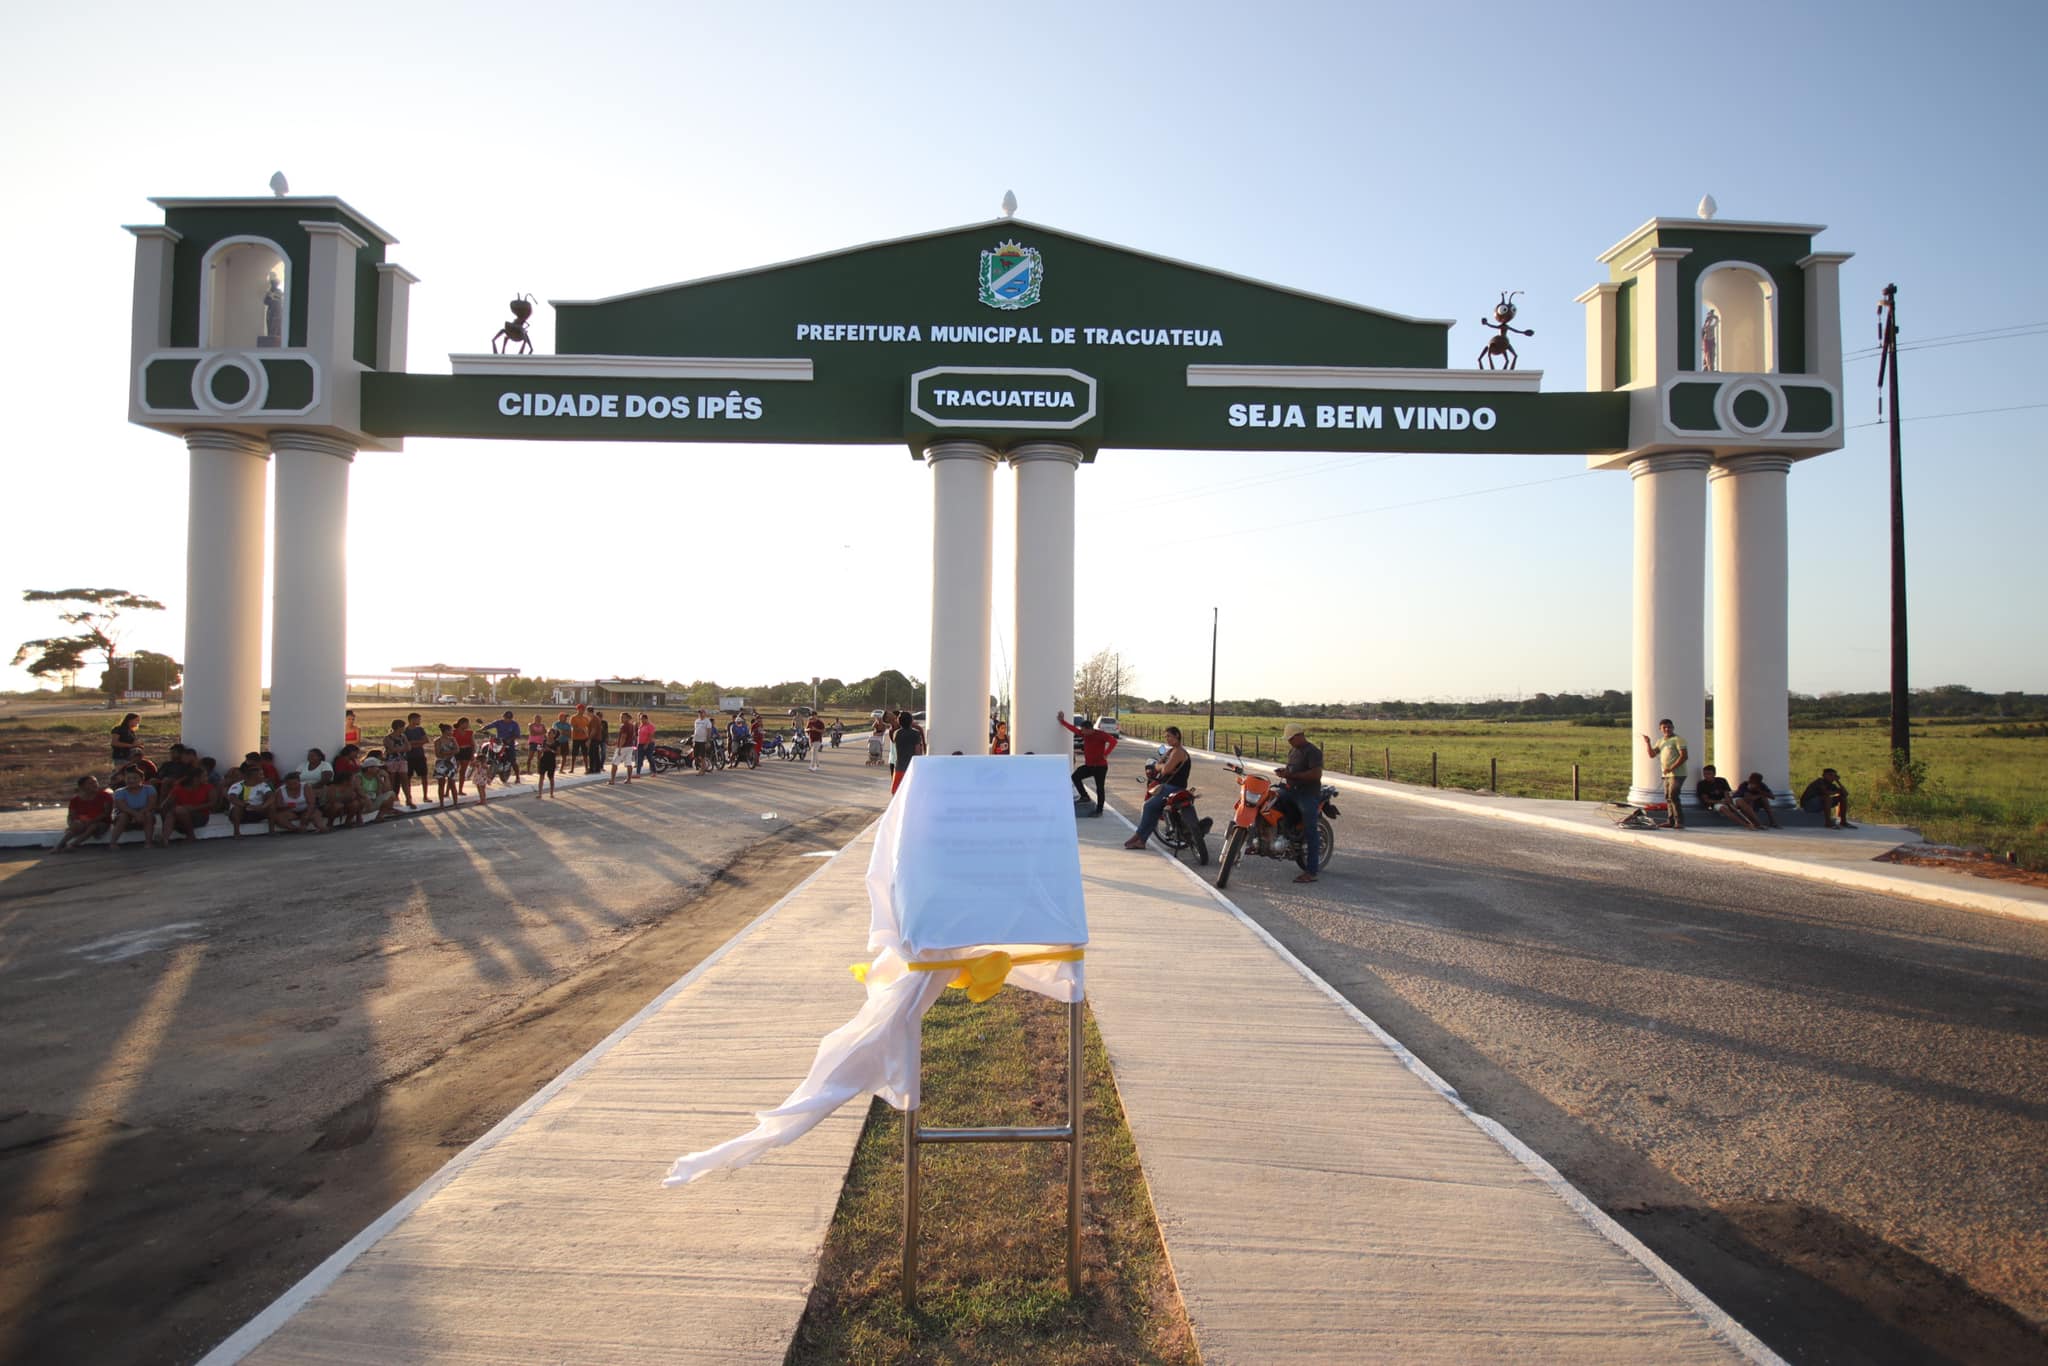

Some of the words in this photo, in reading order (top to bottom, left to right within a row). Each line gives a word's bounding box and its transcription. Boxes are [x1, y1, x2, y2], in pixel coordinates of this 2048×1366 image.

[797, 324, 921, 343] PREFEITURA
[931, 326, 1043, 345] MUNICIPAL
[1051, 327, 1076, 345] DE
[1084, 328, 1223, 347] TRACUATEUA
[498, 392, 618, 418] CIDADE
[625, 395, 690, 420] DOS
[697, 390, 763, 420] IPÊS
[934, 389, 1075, 408] TRACUATEUA
[1228, 404, 1306, 428] SEJA
[1316, 405, 1382, 429] BEM
[1394, 406, 1497, 431] VINDO
